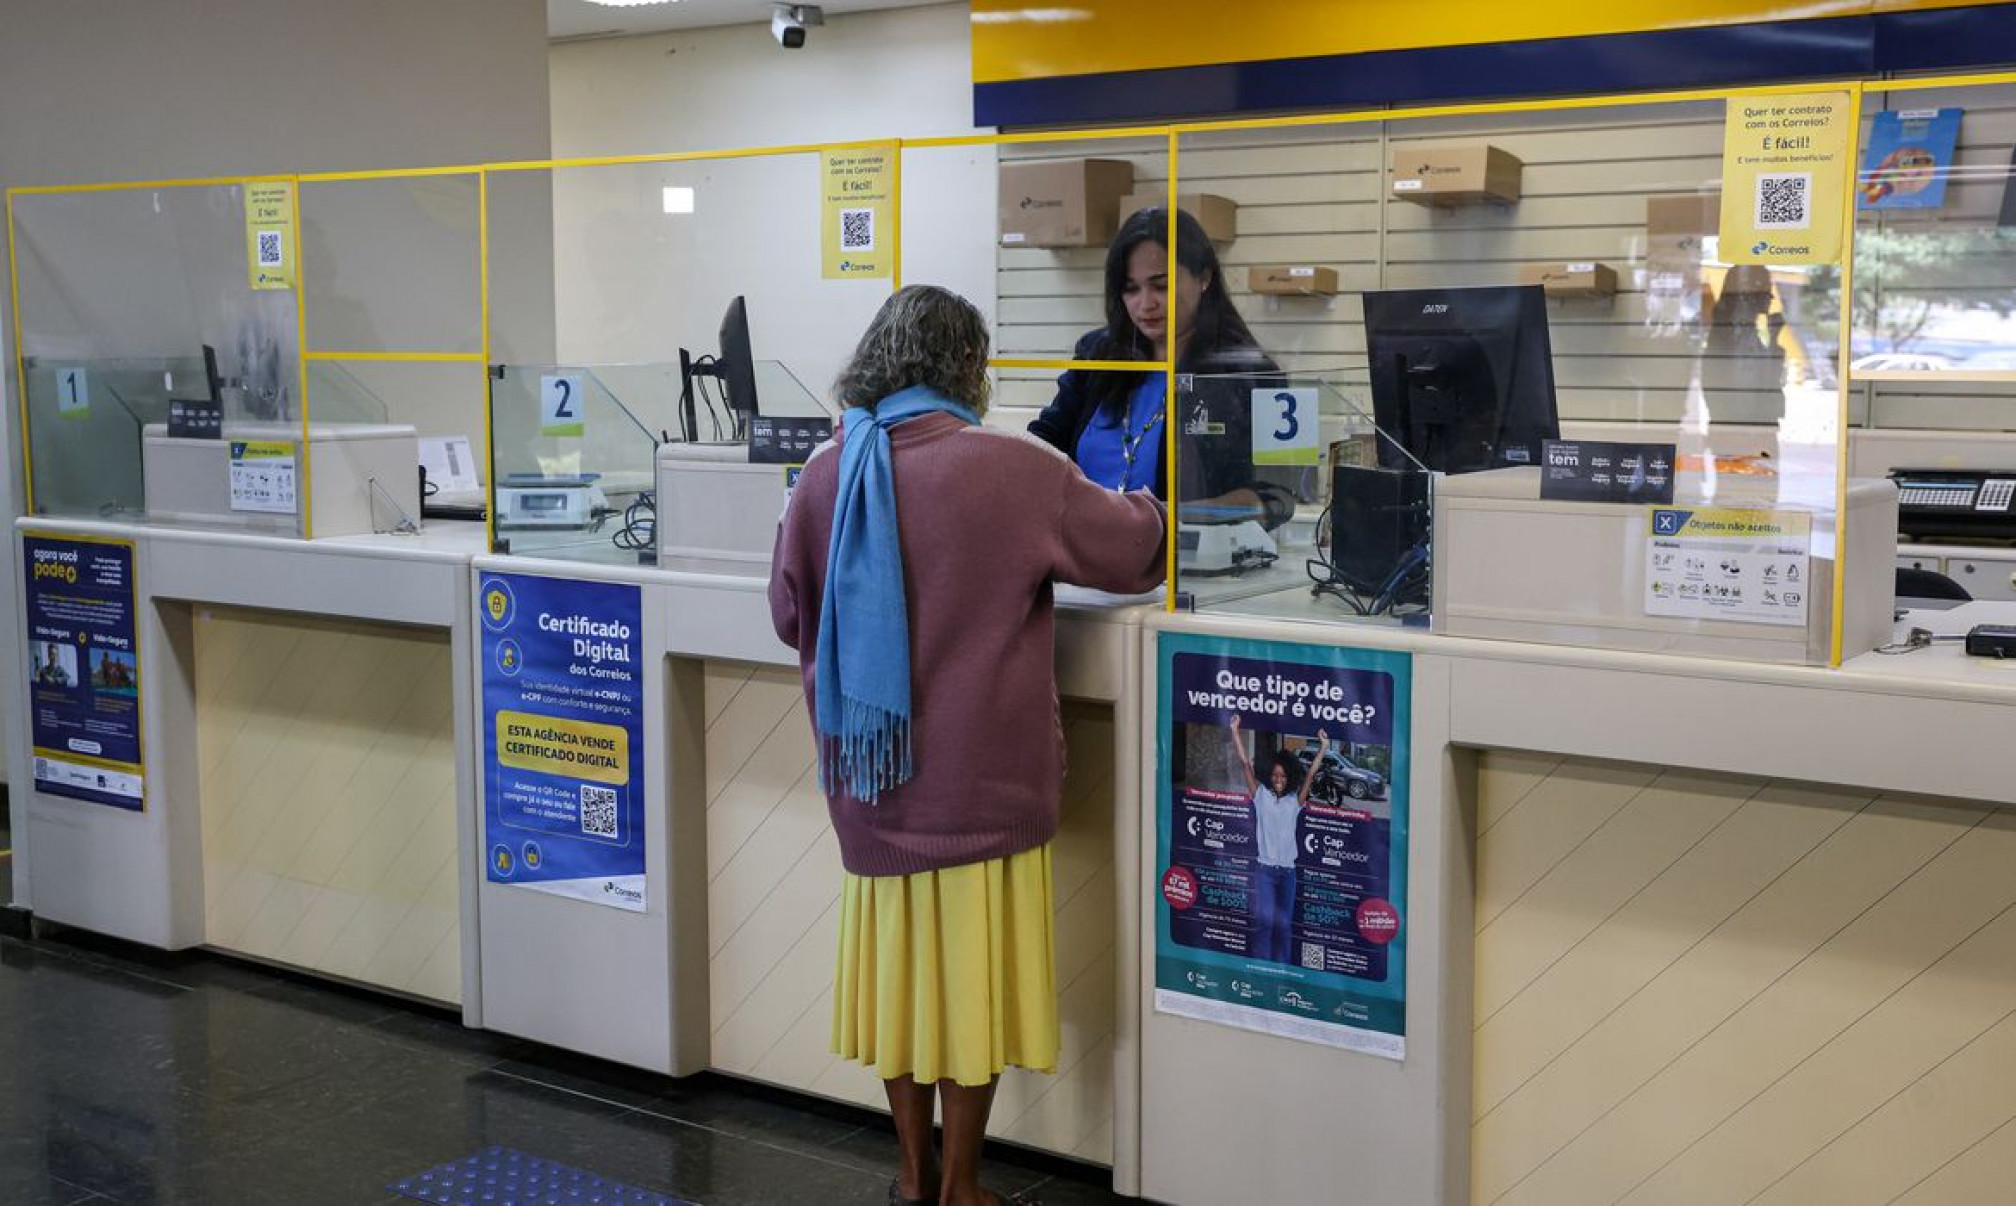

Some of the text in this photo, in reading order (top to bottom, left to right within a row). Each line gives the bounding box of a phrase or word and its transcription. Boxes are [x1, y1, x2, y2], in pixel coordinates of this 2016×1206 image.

[1744, 105, 1833, 117] Quer ter contrato
[1745, 117, 1830, 129] com os Correios?
[1762, 135, 1810, 150] É fácil!
[1769, 245, 1810, 255] Correios
[1422, 304, 1450, 314] DATEN
[66, 372, 77, 403] 1
[554, 379, 573, 418] 2
[1273, 392, 1299, 441] 3
[1549, 454, 1579, 466] tem
[1690, 520, 1781, 533] Objetos não aceitos
[34, 549, 78, 562] agora você
[34, 562, 65, 580] pode
[538, 613, 630, 640] Certificado
[573, 639, 630, 664] Digital
[570, 663, 631, 681] dos Correios
[1216, 669, 1343, 701] Que tipo de
[1188, 690, 1376, 725] vencedor é você?
[508, 725, 615, 751] ESTA AGÊNCIA VENDE
[506, 742, 619, 769] CERTIFICADO DIGITAL
[1205, 818, 1224, 831] Cap
[1206, 829, 1250, 844] Vencedor
[1324, 836, 1344, 850] Cap
[1324, 847, 1369, 863] Vencedor
[614, 887, 641, 898] Correios
[1202, 885, 1247, 899] Cashback
[1304, 903, 1349, 917] Cashback
